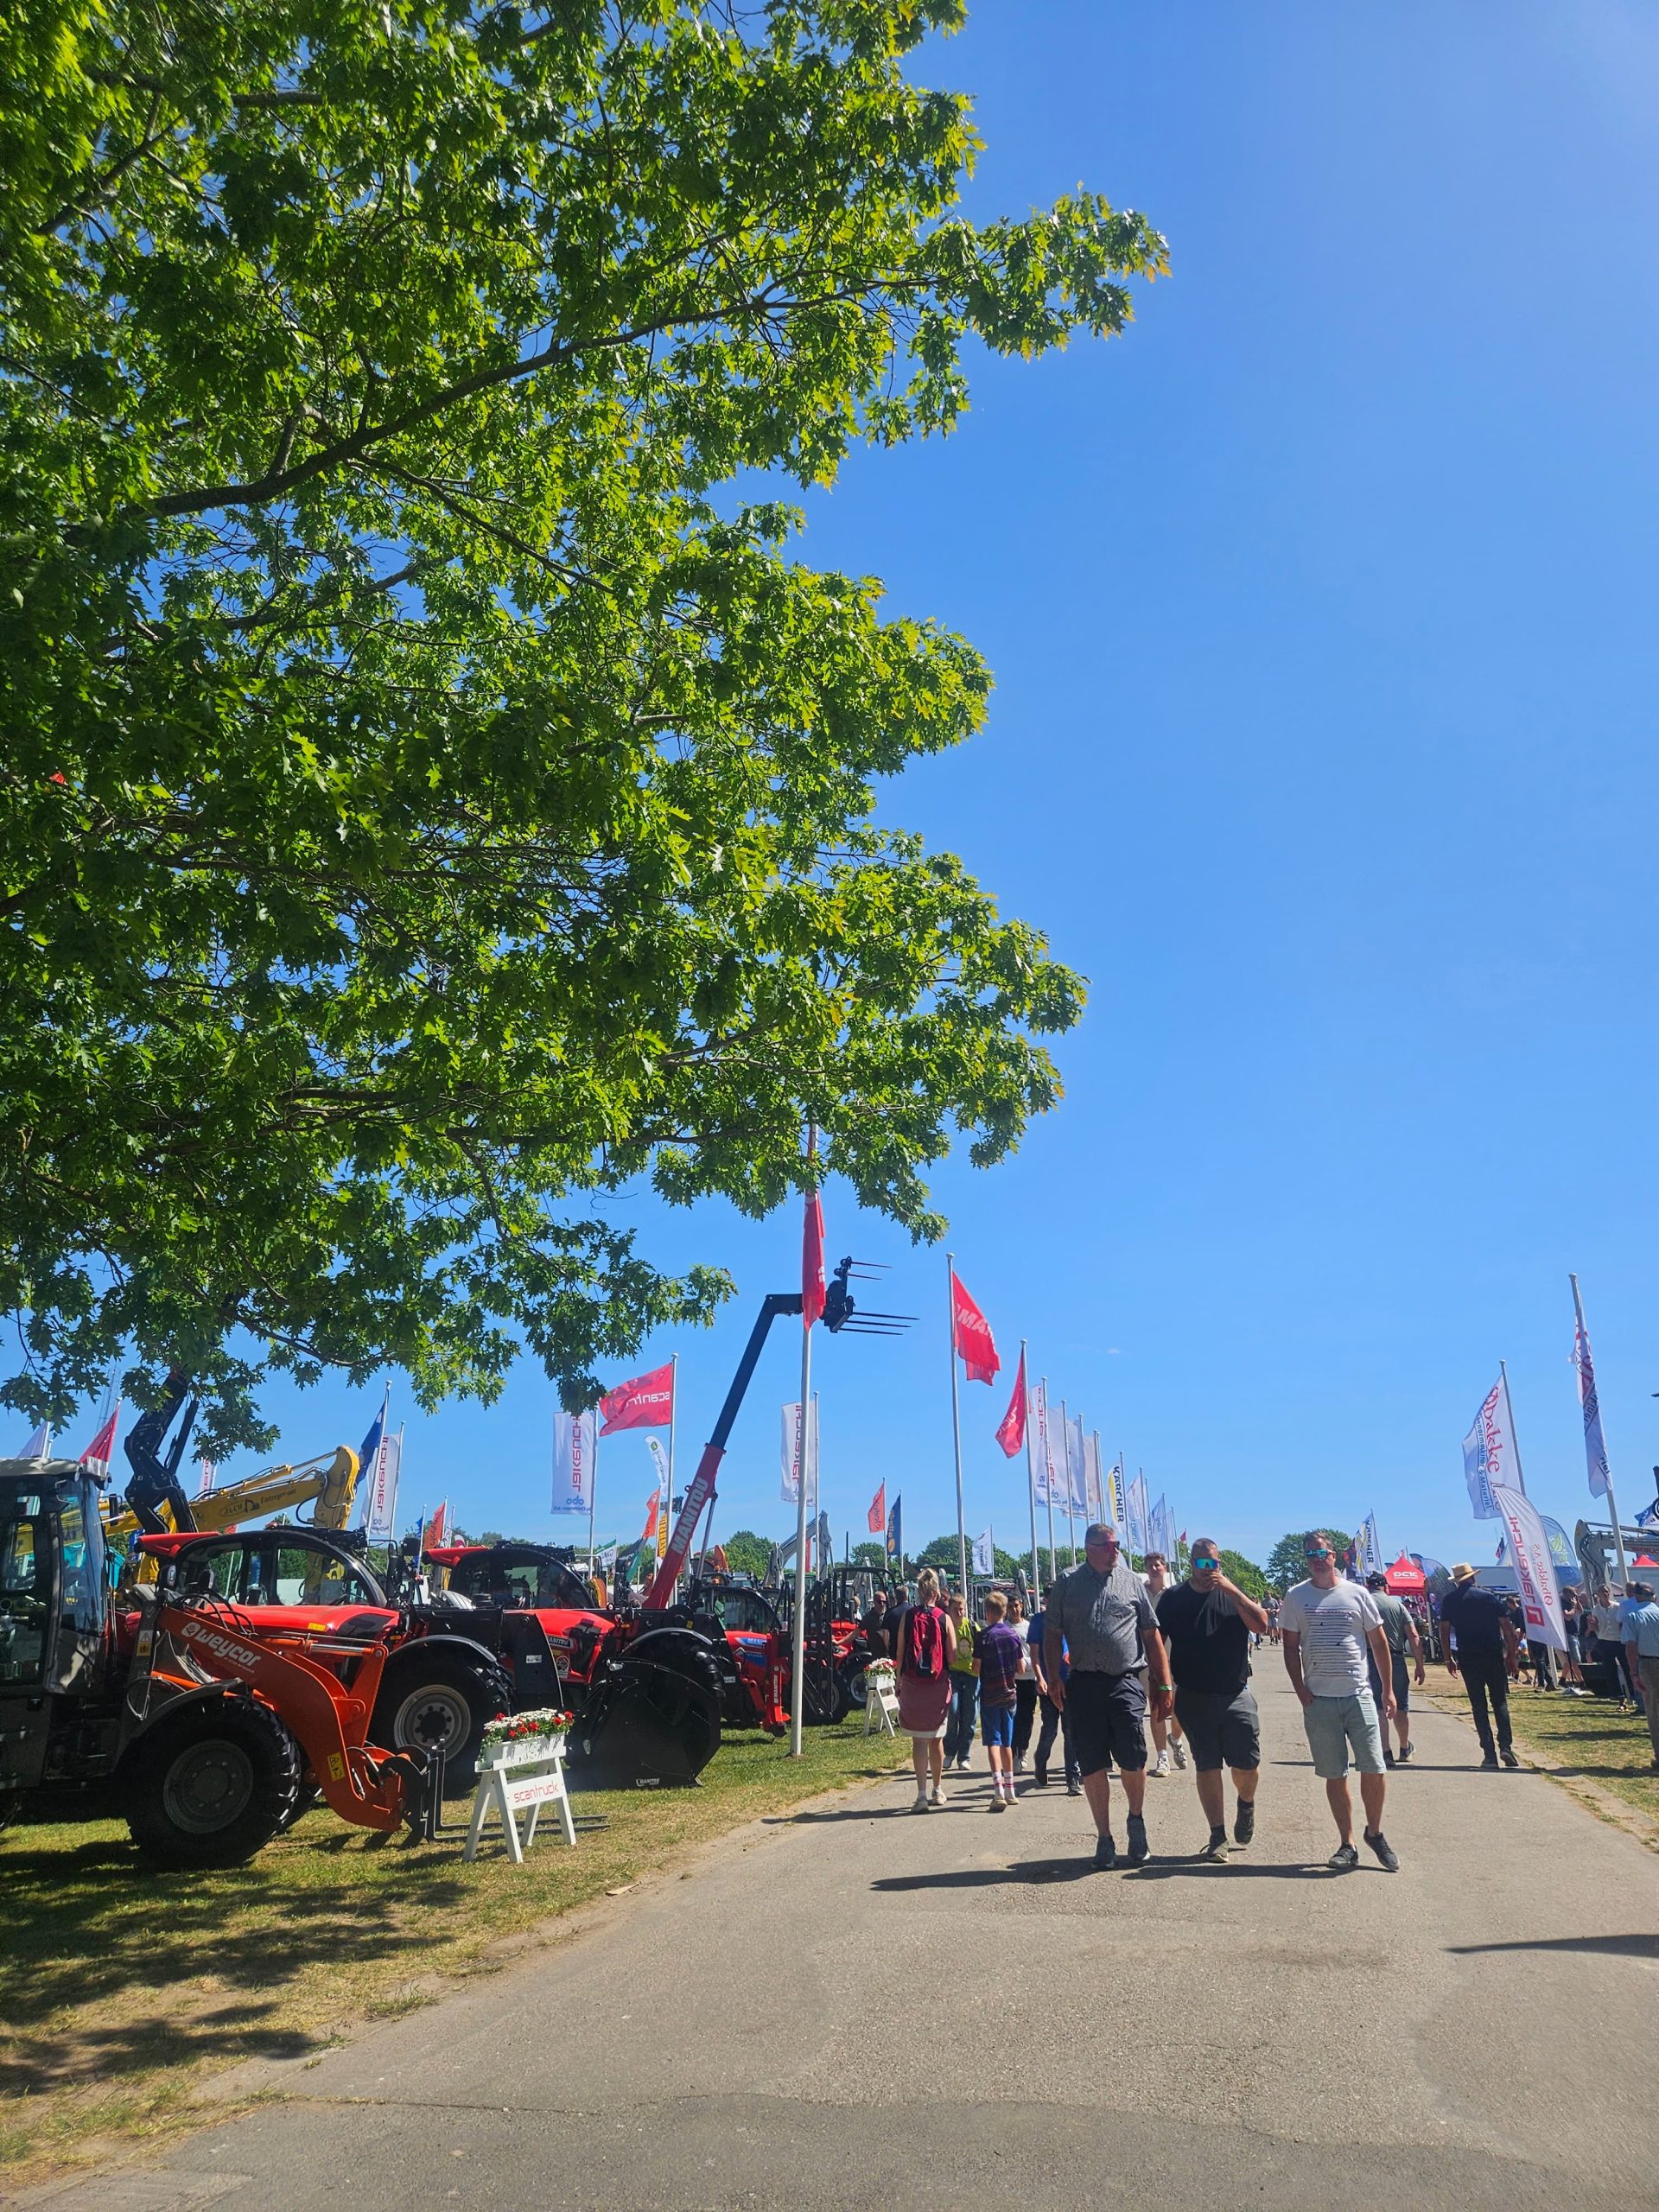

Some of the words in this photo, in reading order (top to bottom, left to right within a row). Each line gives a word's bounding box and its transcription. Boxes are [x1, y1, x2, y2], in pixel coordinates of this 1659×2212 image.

[671, 1477, 709, 1554] MANITOU
[194, 1628, 262, 1667] weycor
[549, 1637, 569, 1646] ANITOU
[513, 1780, 560, 1803] scantruck
